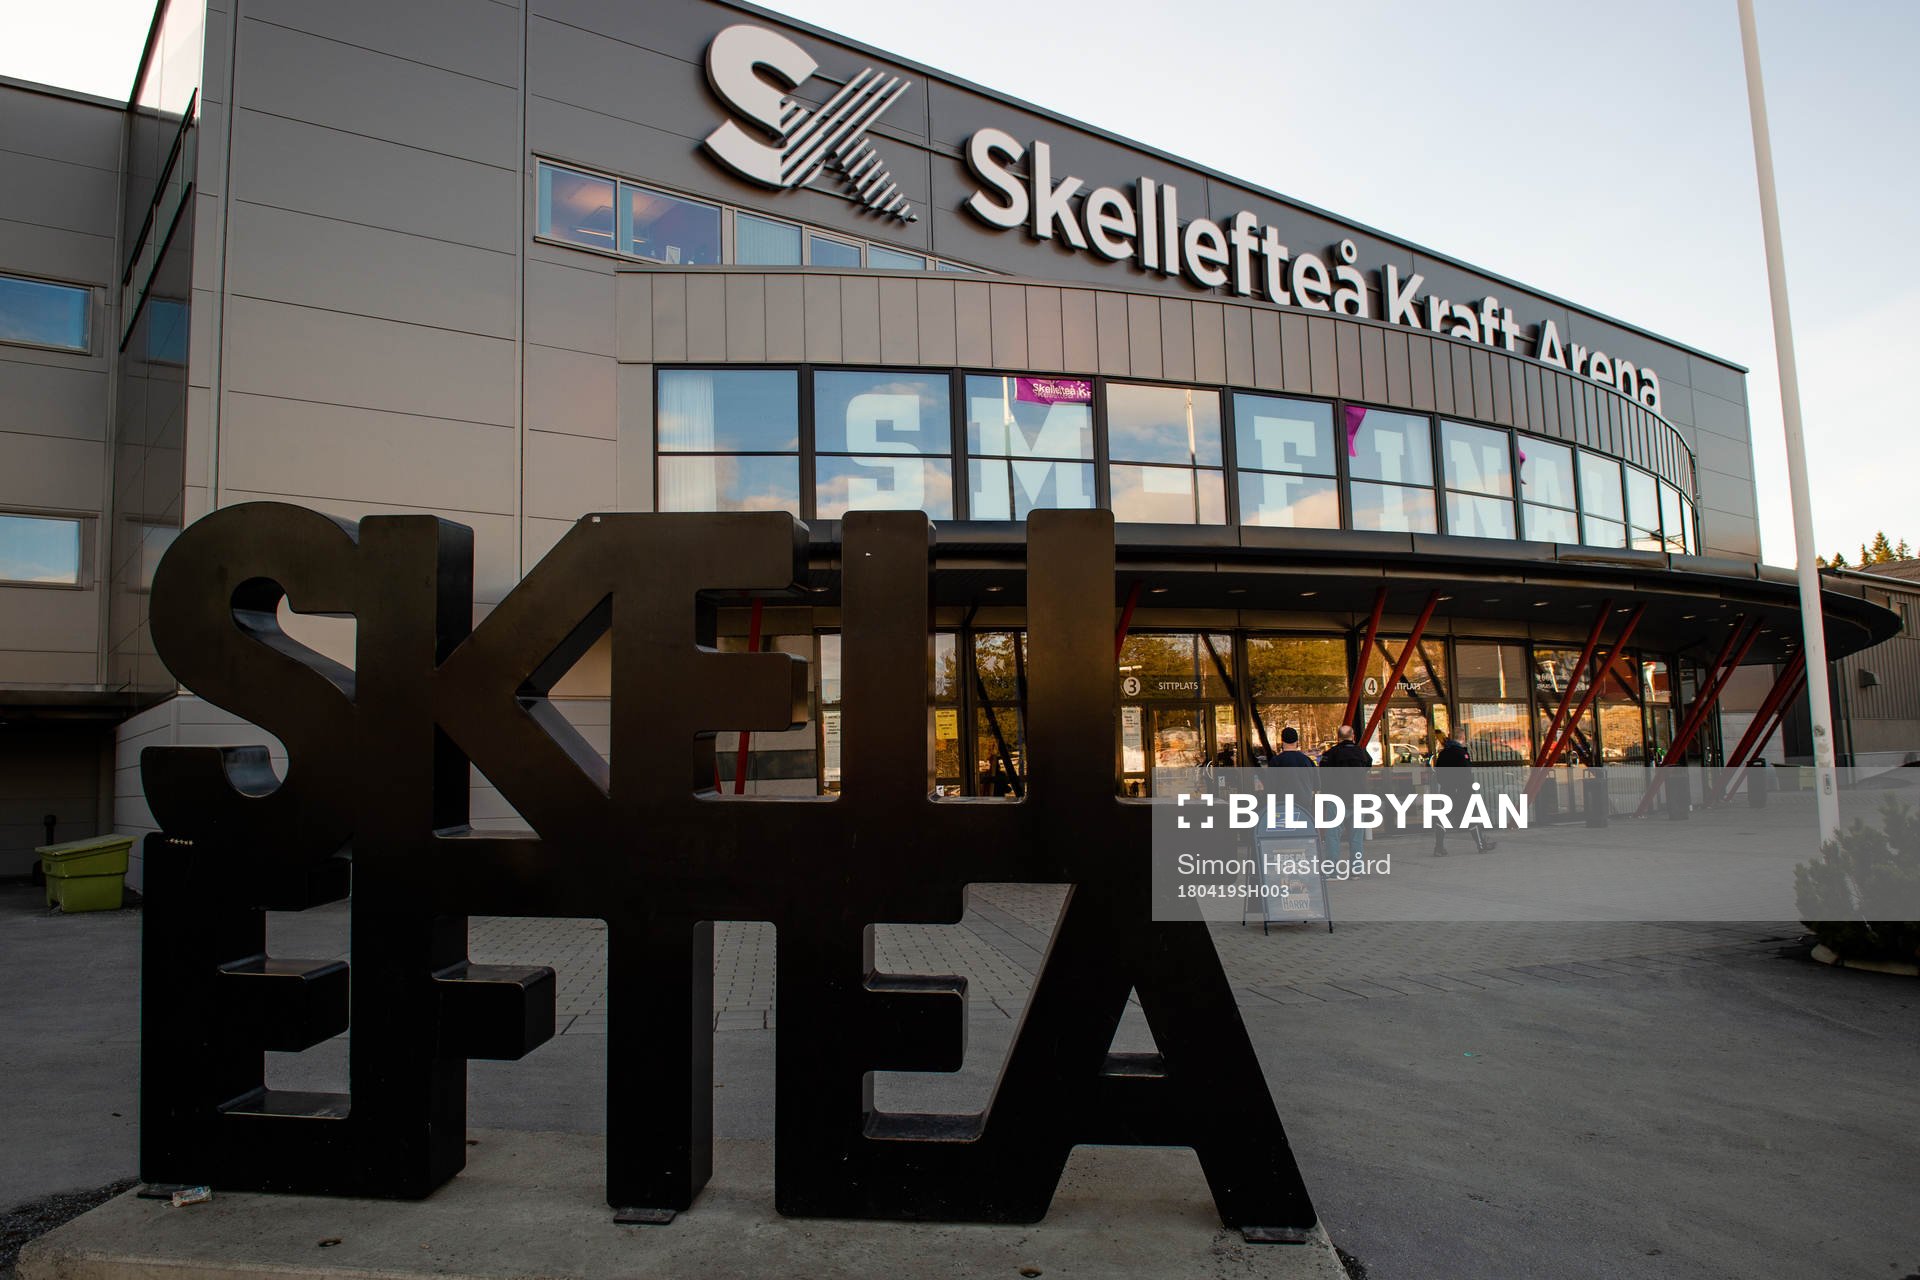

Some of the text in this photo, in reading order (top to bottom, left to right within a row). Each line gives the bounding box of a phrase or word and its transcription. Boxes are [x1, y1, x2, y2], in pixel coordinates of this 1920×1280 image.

[965, 128, 1662, 413] Skellefteå Kraft Arena
[1126, 678, 1199, 695] 3 SITTPLATS
[1367, 678, 1421, 694] 4 ITTPLATS
[1283, 898, 1309, 910] HARRY
